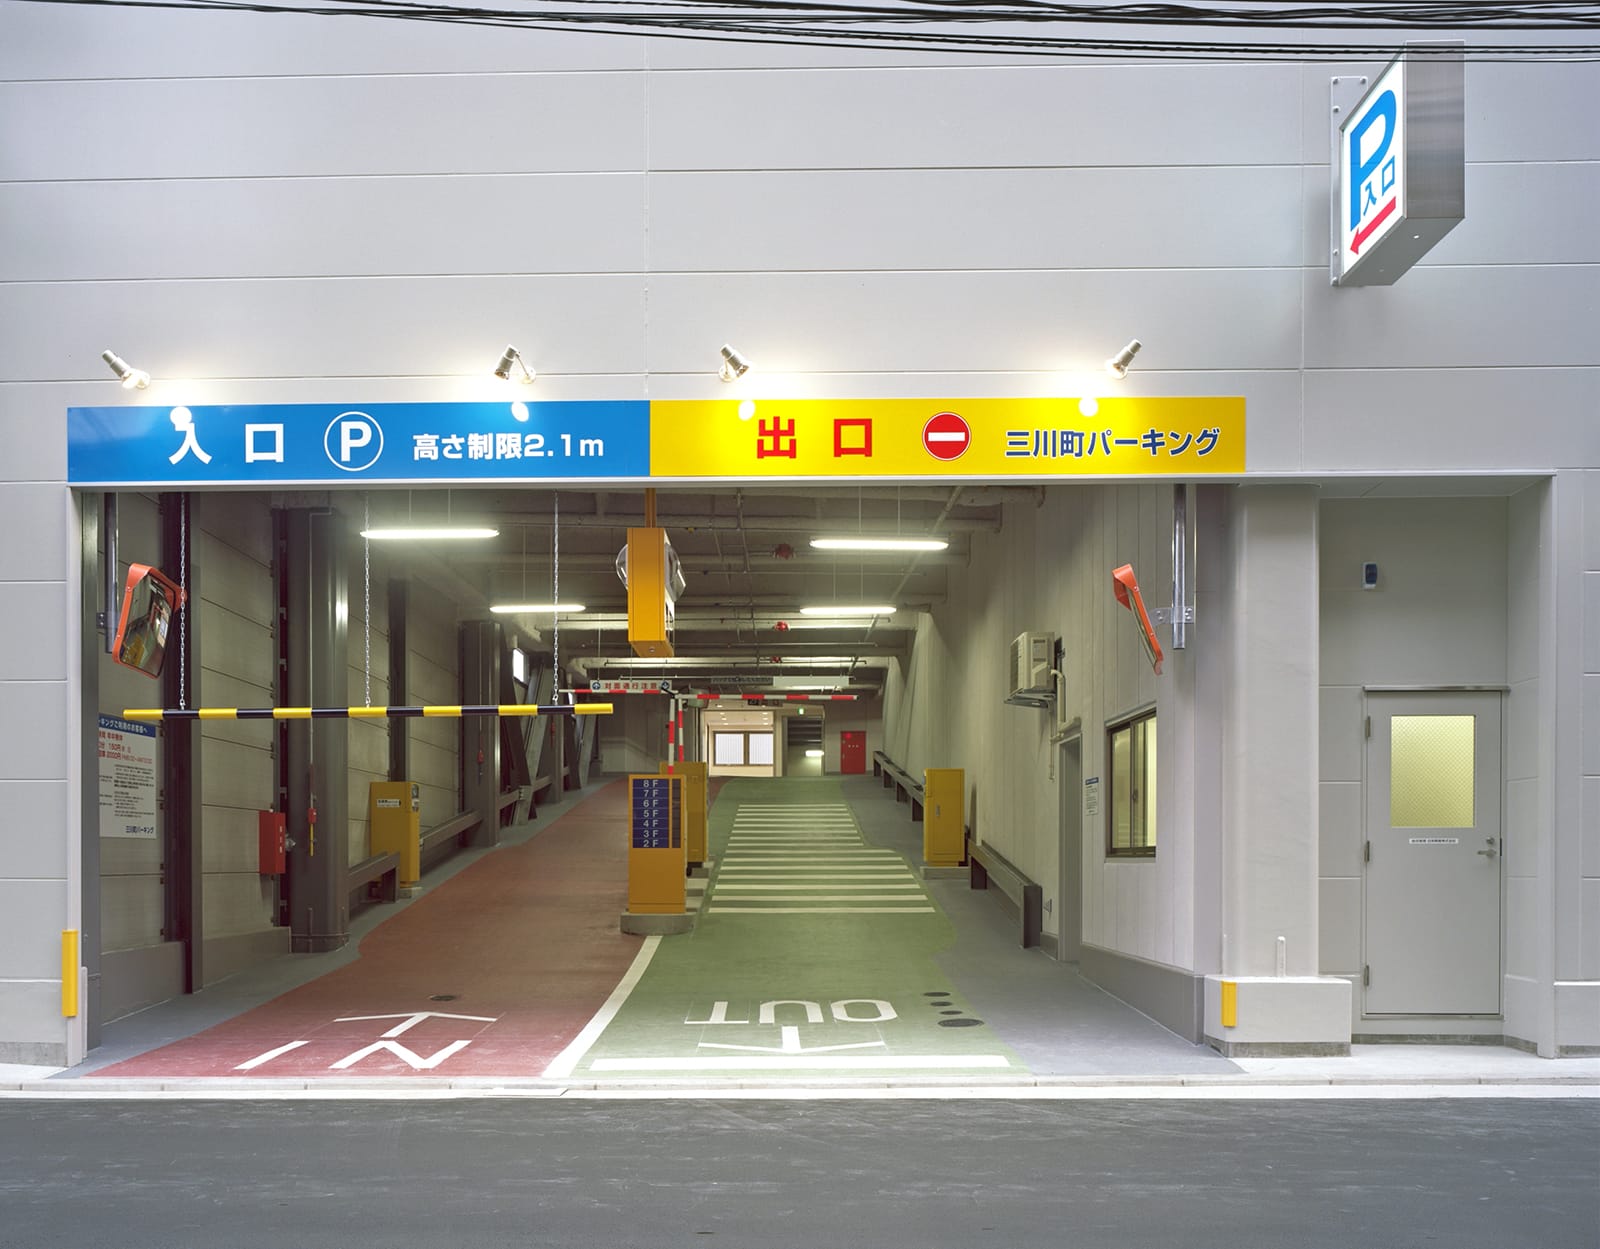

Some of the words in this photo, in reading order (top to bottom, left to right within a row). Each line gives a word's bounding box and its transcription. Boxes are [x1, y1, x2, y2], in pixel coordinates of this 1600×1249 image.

[1350, 89, 1397, 232] P
[1363, 155, 1395, 216] 入口
[168, 421, 284, 465] 入口
[340, 420, 373, 463] P
[412, 433, 605, 461] 高さ制限2.1m
[756, 416, 873, 459] 出口
[1005, 428, 1221, 459] 三川町パーキング
[684, 999, 898, 1025] OUT
[233, 1040, 473, 1070] IN
